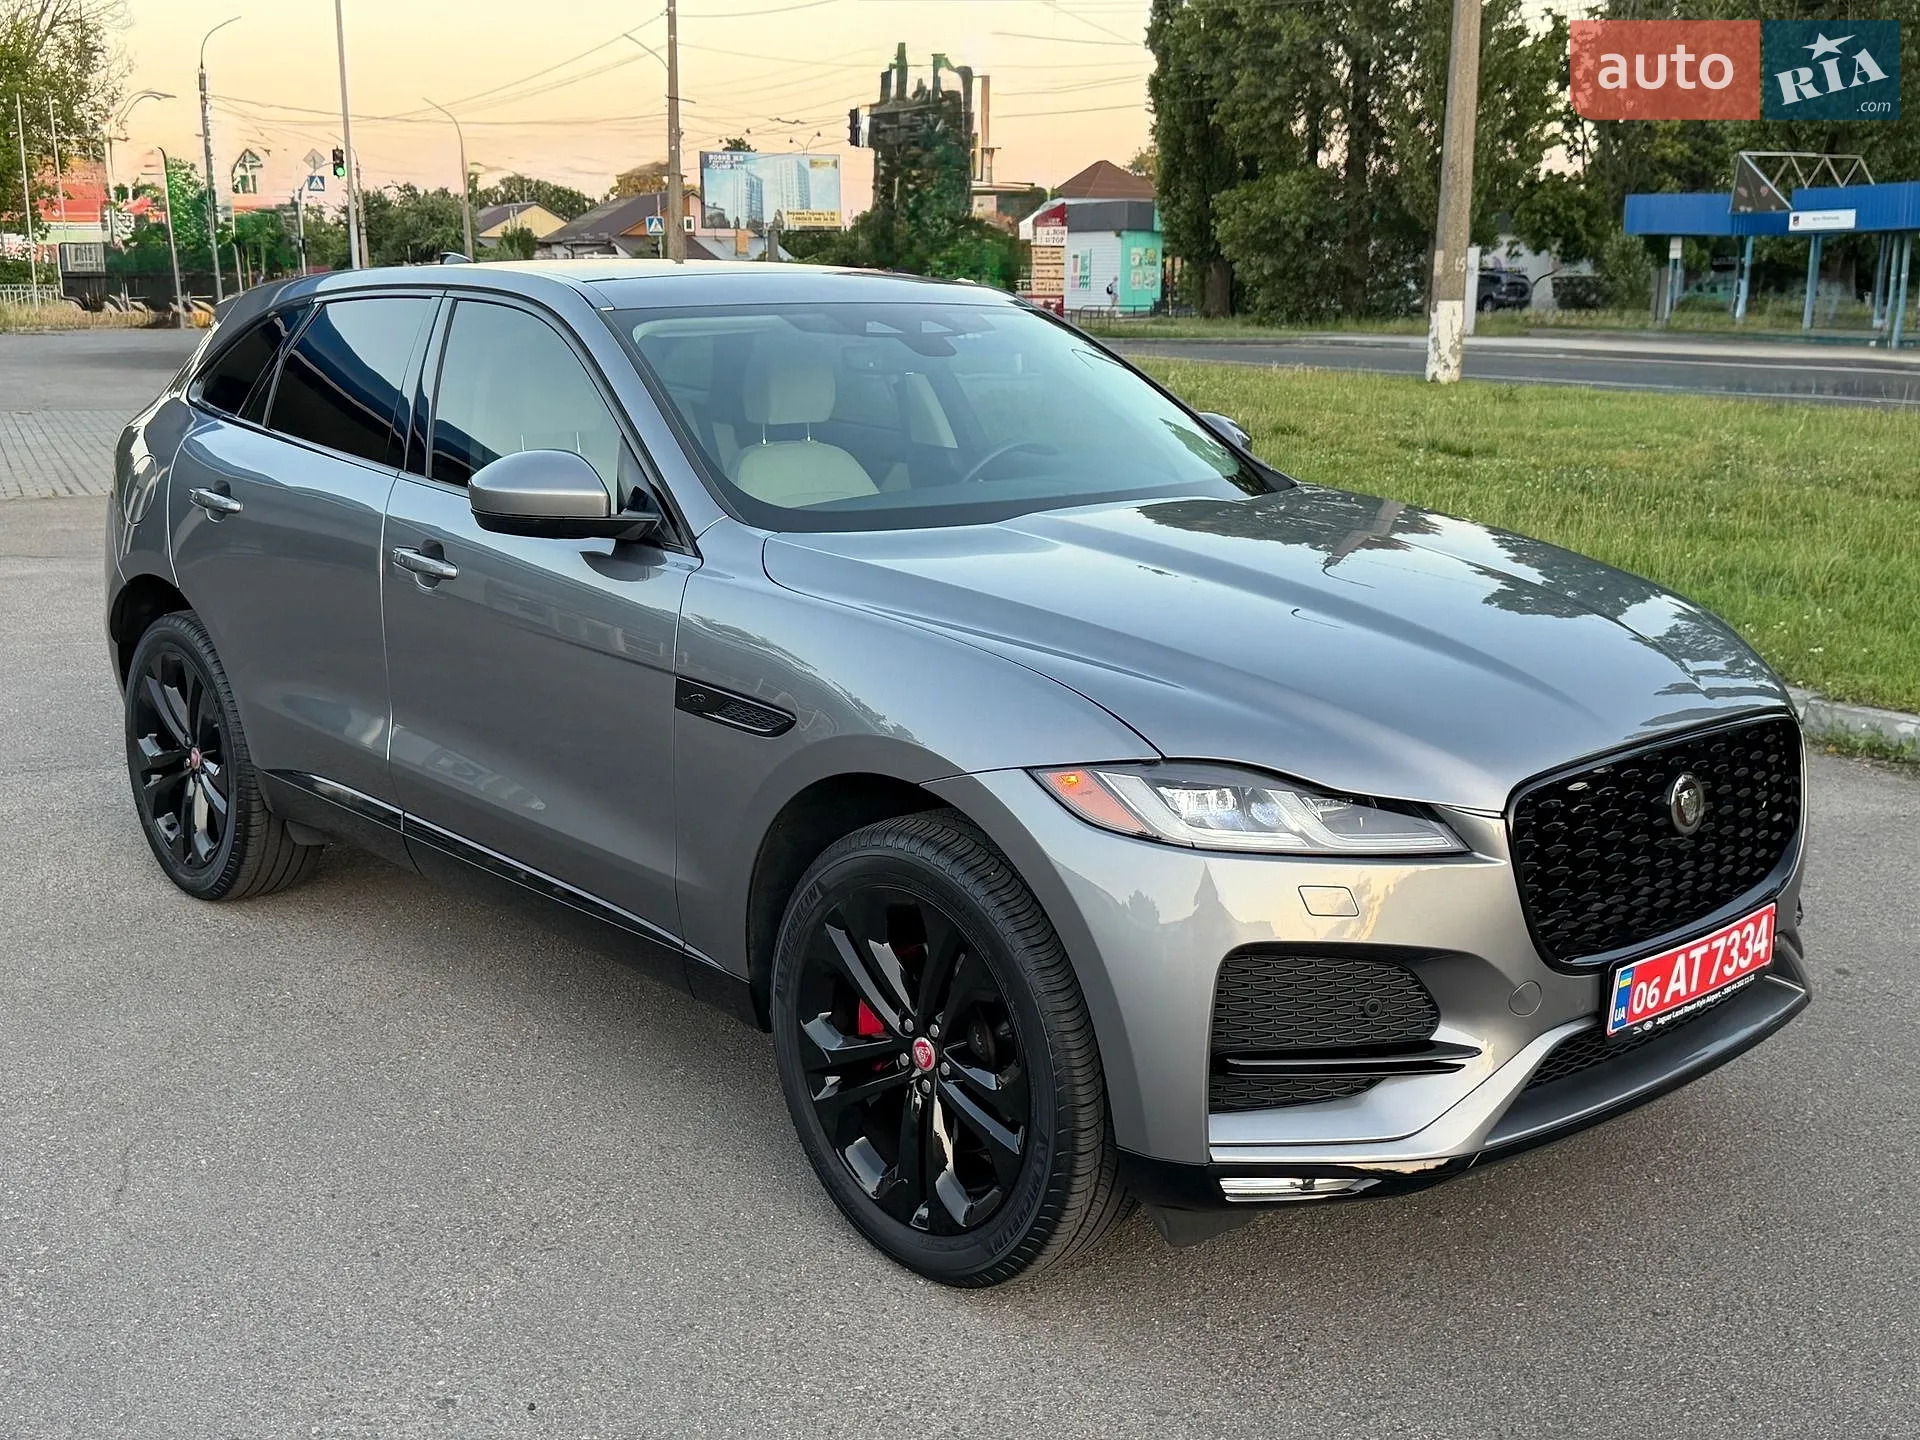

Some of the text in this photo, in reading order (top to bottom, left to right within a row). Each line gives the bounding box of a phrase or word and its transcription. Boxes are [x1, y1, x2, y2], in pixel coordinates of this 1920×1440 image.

[1632, 976, 1662, 1015] 06
[1614, 1007, 1627, 1023] UA
[1656, 1013, 1672, 1025] Jaguar
[1672, 1007, 1684, 1018] Land
[1683, 1002, 1697, 1013] Rover
